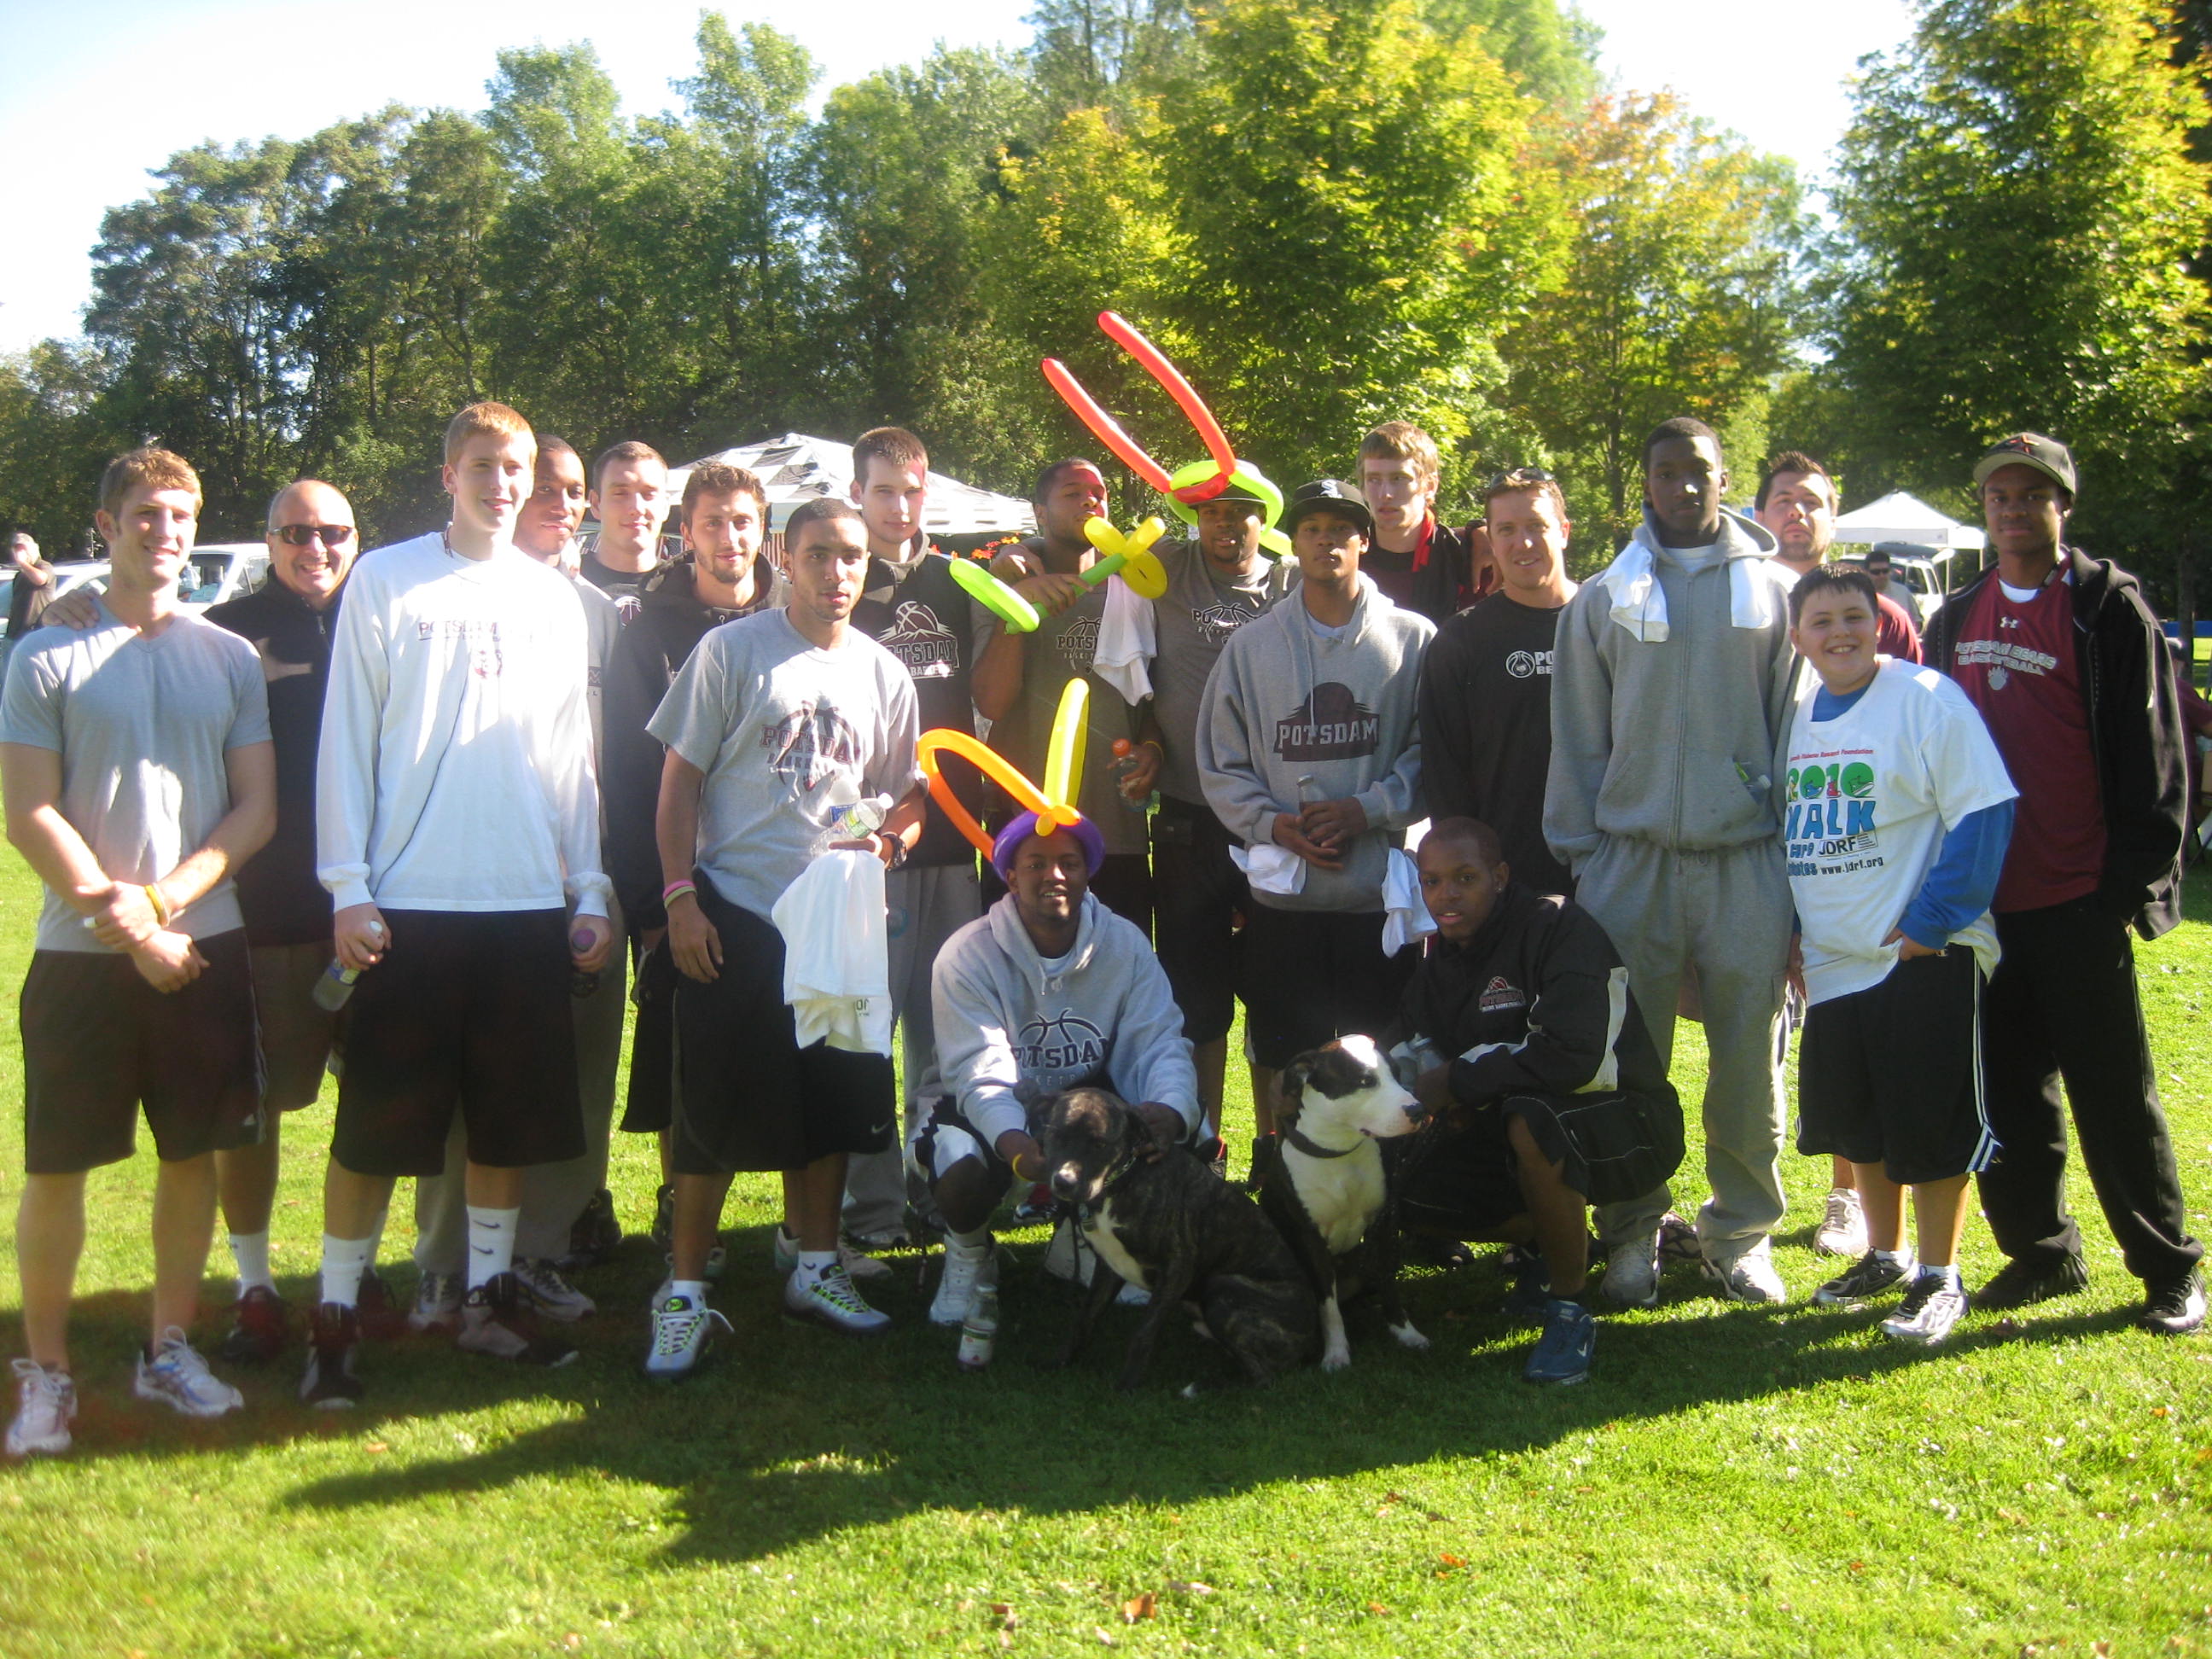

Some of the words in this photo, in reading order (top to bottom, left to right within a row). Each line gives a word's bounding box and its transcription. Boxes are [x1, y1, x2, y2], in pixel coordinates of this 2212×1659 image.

[1278, 718, 1379, 749] POTSDAM
[1788, 762, 1874, 802] 2010
[1819, 835, 1856, 855] JDRF
[1819, 856, 1883, 876] www.jdrf.org
